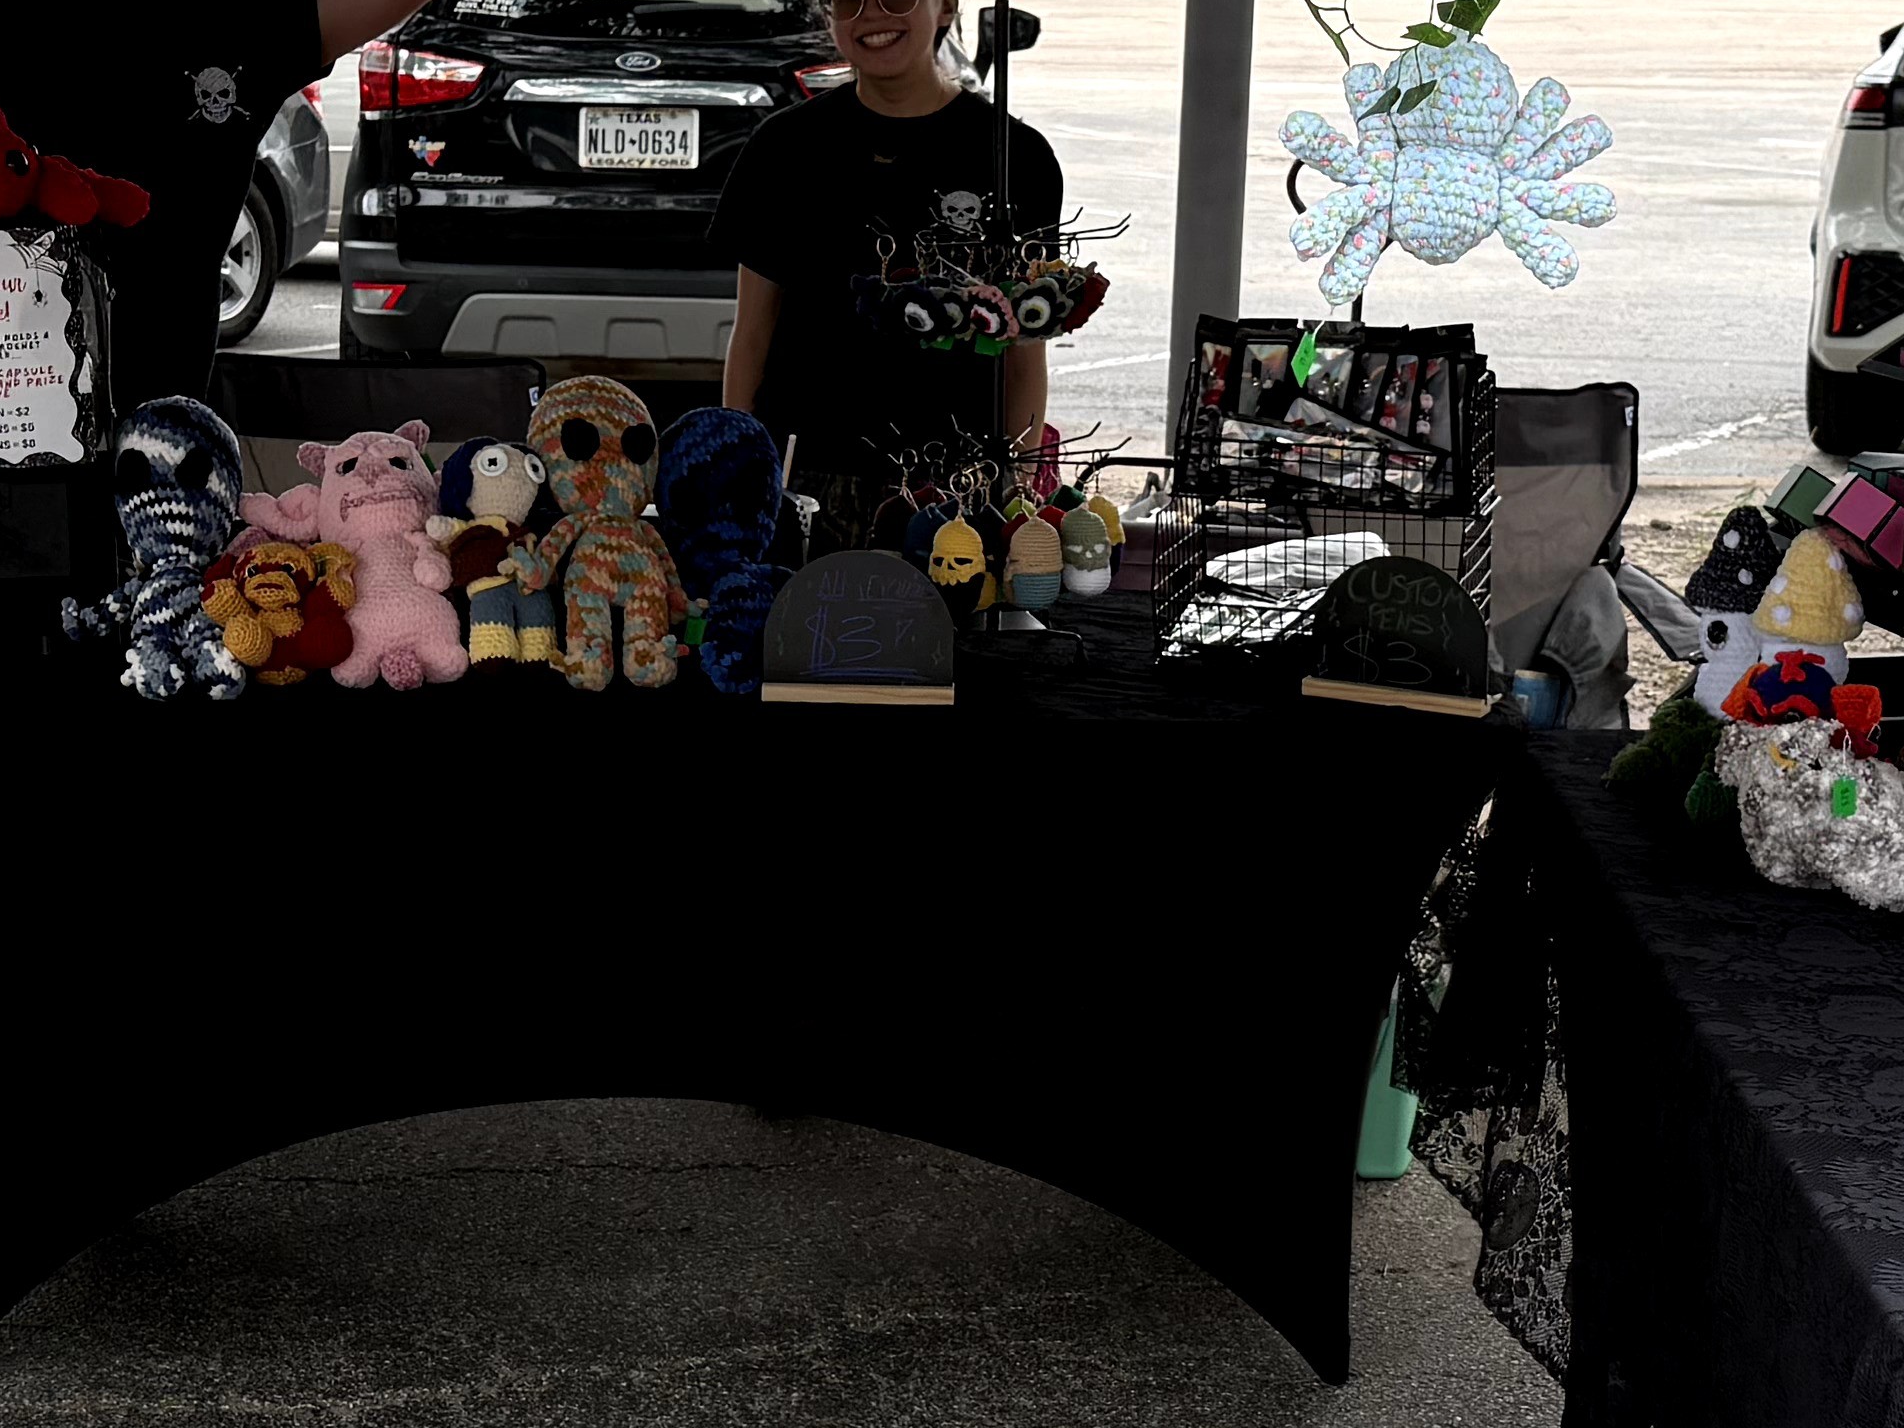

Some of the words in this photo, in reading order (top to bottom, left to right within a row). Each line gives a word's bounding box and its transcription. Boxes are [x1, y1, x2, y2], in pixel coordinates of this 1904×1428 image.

[619, 113, 662, 124] TEXAS
[589, 157, 647, 167] LEGACY
[649, 157, 690, 167] FORD
[4, 331, 39, 342] HOLDS
[26, 374, 65, 388] PRIZE
[14, 406, 30, 418] $2
[1347, 565, 1465, 612] CUSTOM
[805, 604, 883, 672] $3
[1342, 625, 1434, 686] $3
